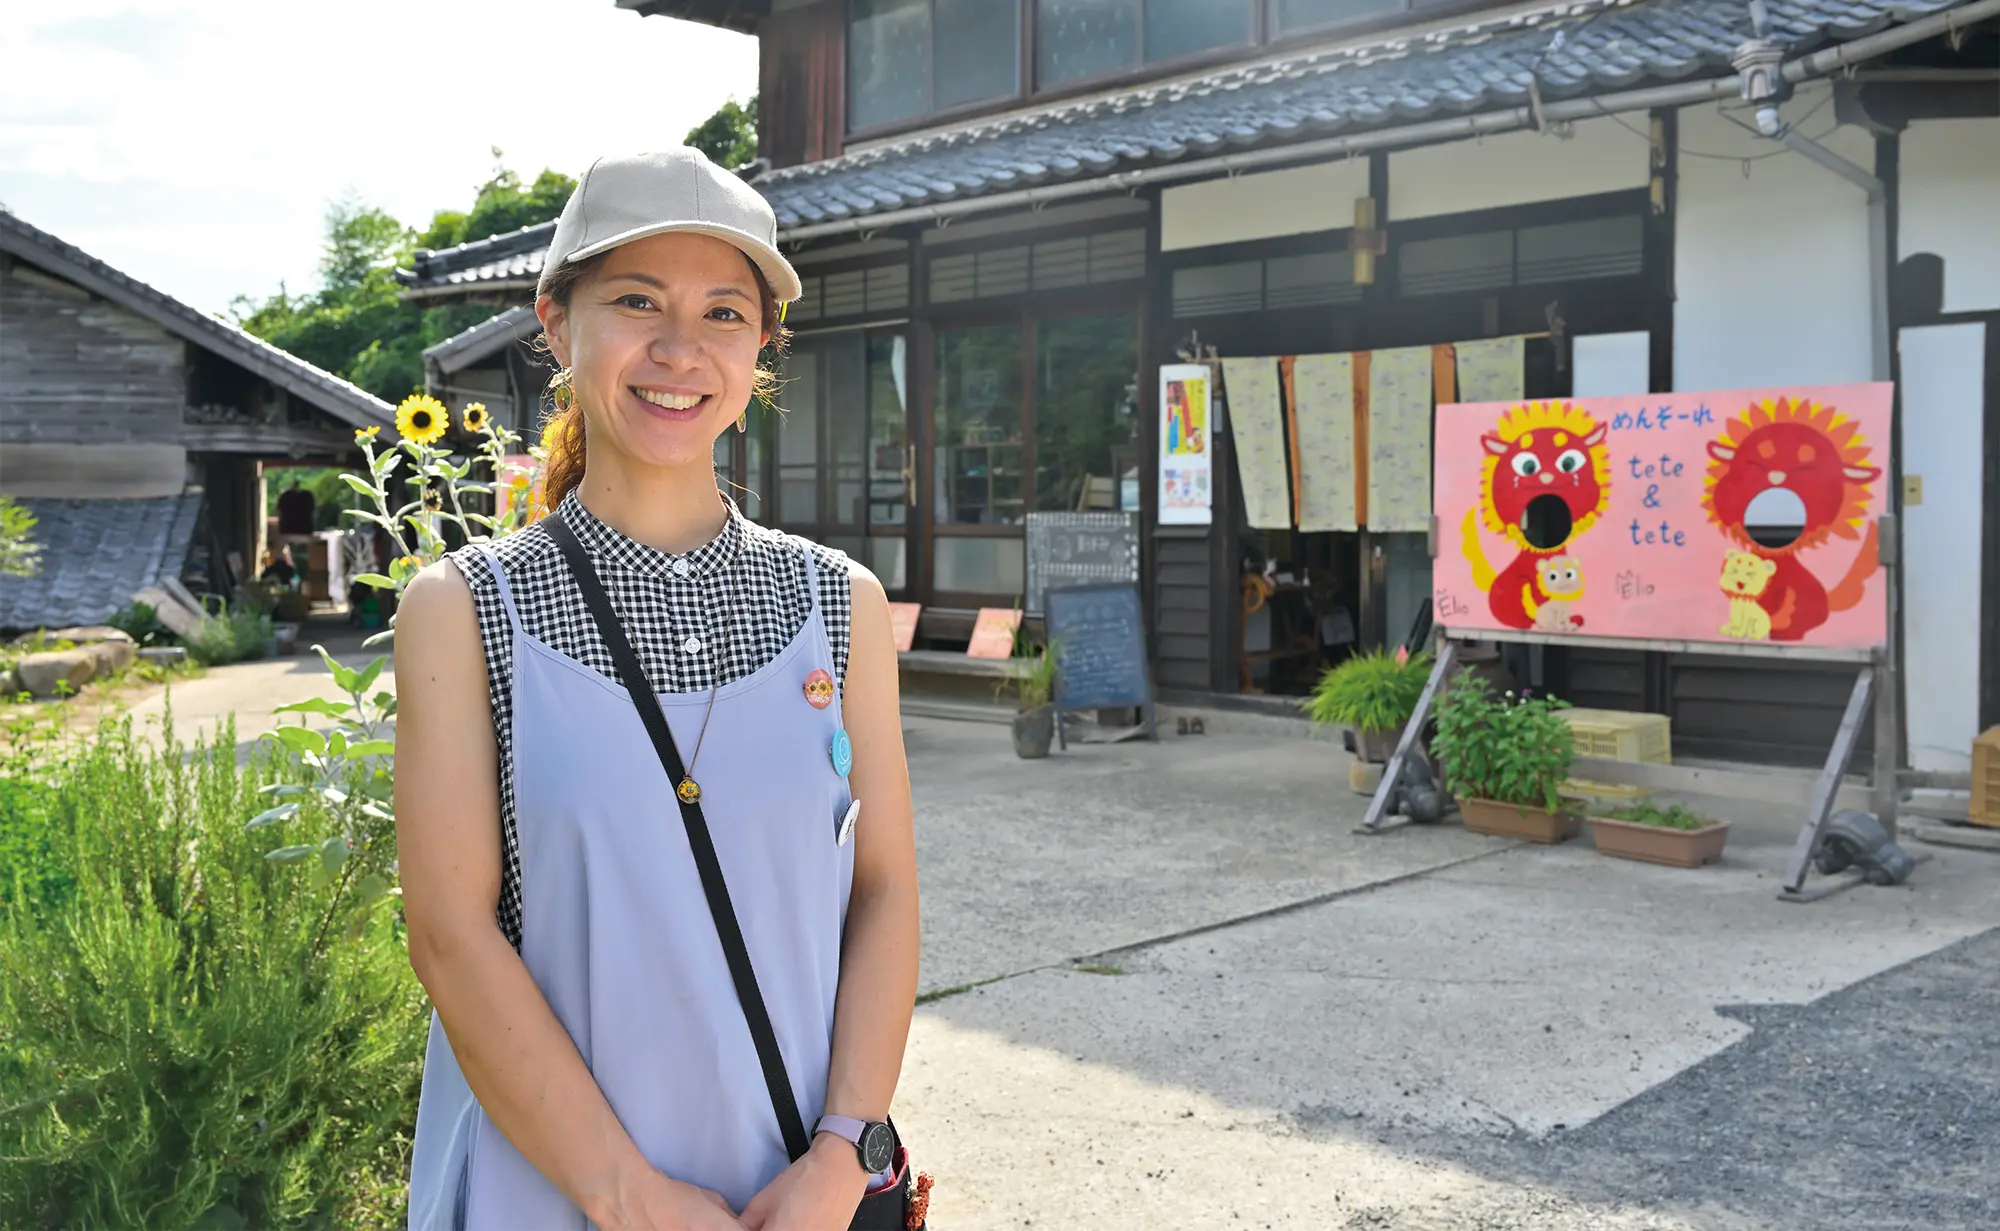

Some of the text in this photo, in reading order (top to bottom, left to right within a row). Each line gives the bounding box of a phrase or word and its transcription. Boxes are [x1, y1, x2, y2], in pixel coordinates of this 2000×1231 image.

[1611, 403, 1715, 431] めんそーれ
[1628, 455, 1684, 479] tete
[1642, 483, 1661, 508] &
[1629, 518, 1686, 546] tete
[1620, 580, 1655, 600] Elio
[1438, 595, 1469, 618] Elio
